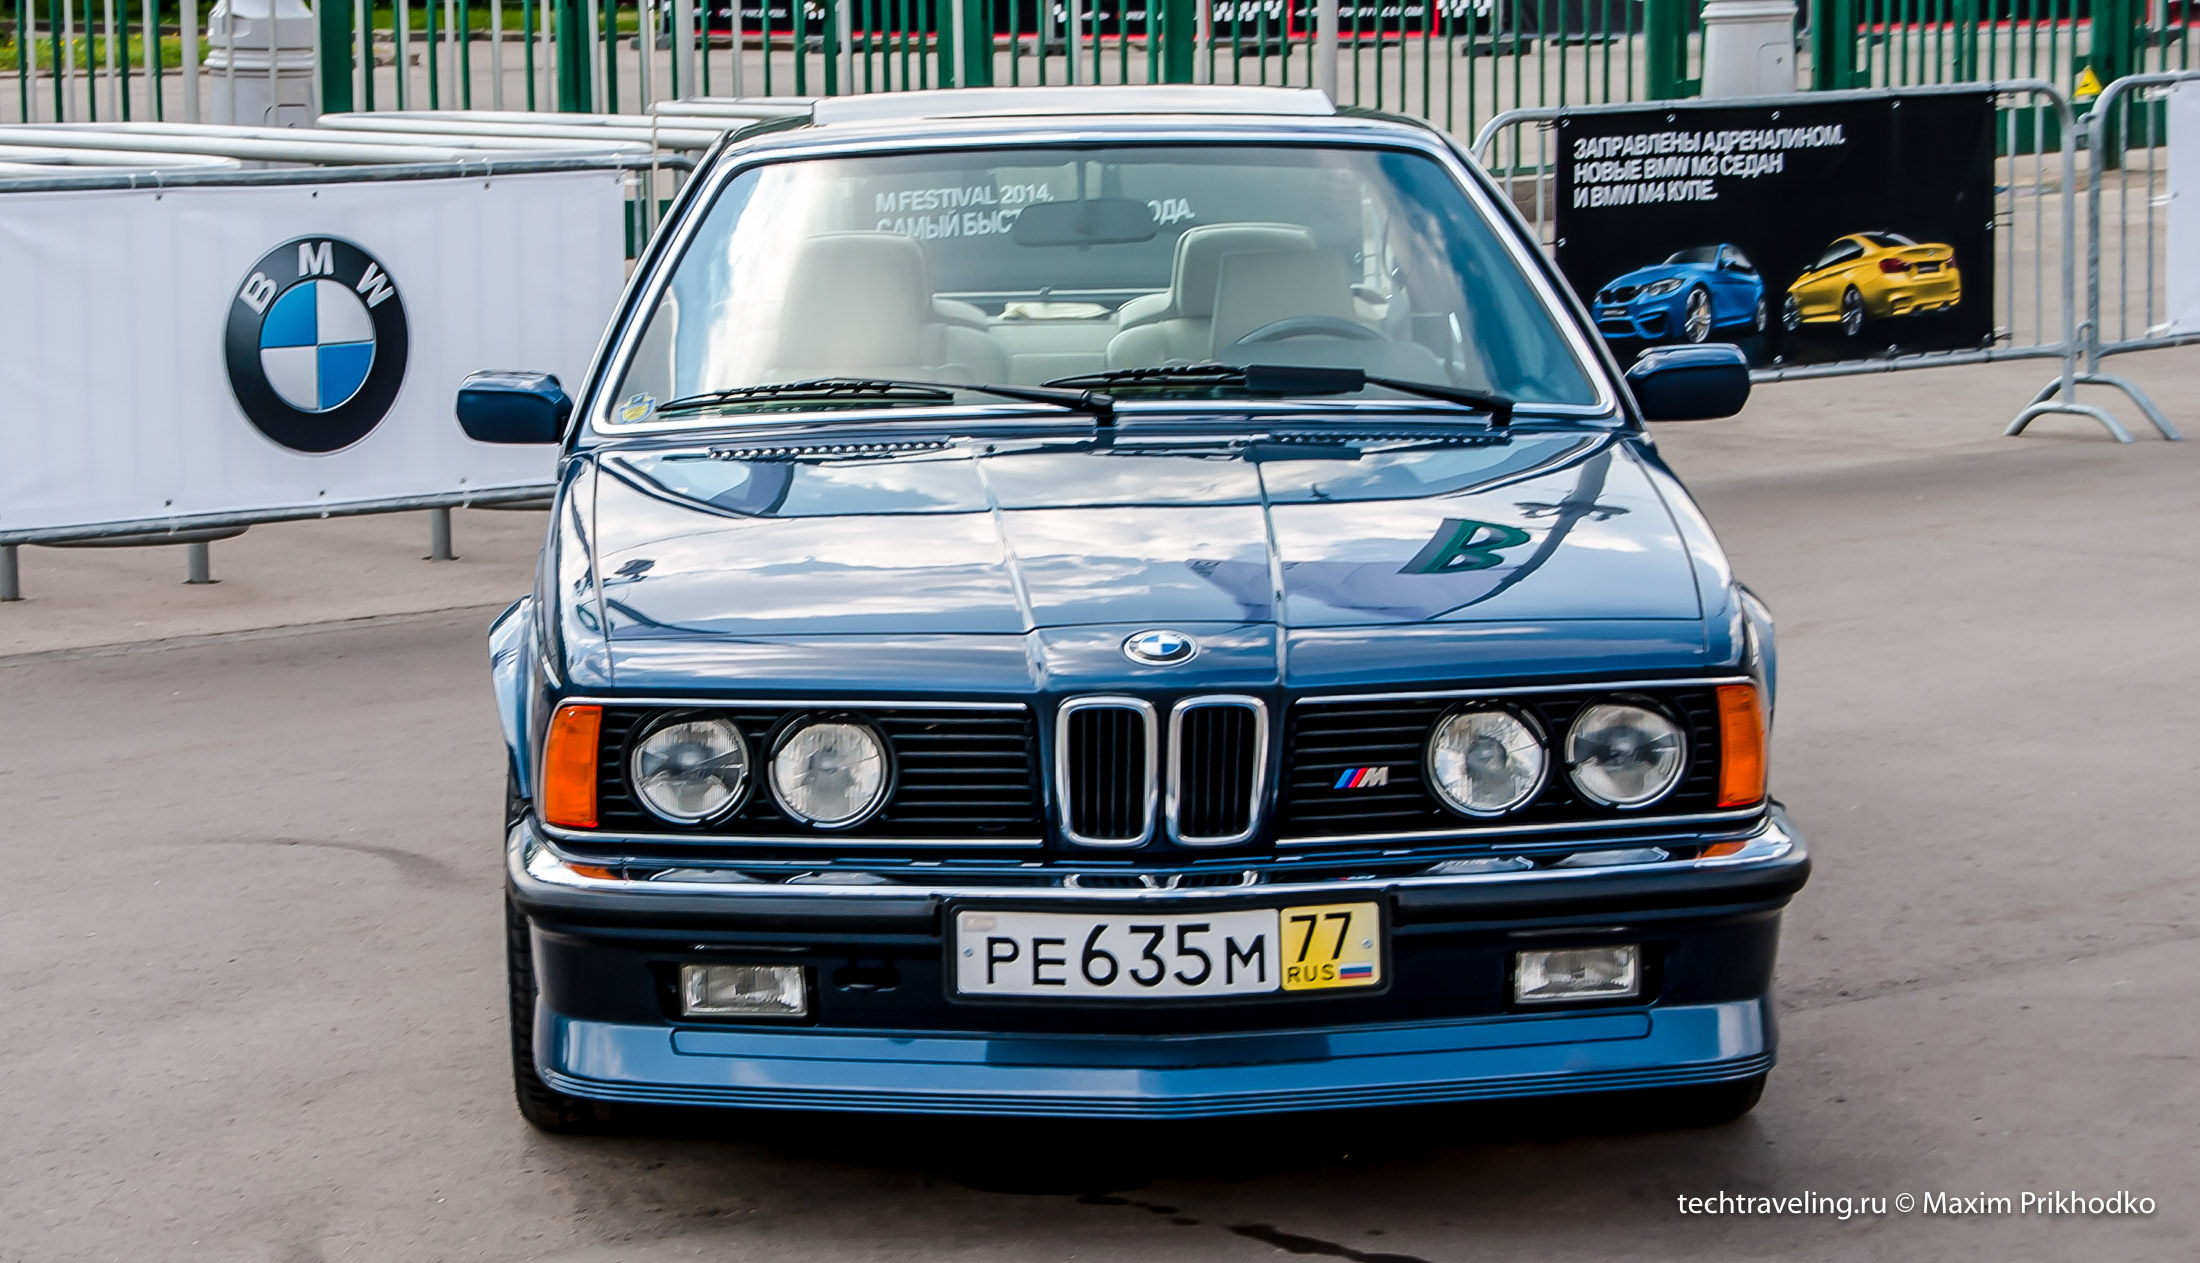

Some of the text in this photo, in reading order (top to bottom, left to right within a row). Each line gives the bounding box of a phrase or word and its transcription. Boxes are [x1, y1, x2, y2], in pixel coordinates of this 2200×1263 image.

[1573, 125, 1846, 159] ЗАПРАВЛЕНЫ АДРЕНАЛИНОМ.
[1573, 152, 1785, 184] НОВЫЕ BMW M3 СЕДАН
[875, 191, 896, 213] M
[898, 184, 999, 212] FESTIVAL
[1573, 179, 1718, 209] И BMW M4 КУПЕ.
[875, 208, 961, 240] САМЫЙ
[961, 208, 1025, 237] БЫСТ
[238, 240, 395, 316] BMW
[1355, 766, 1389, 788] M
[1288, 911, 1354, 963] 77
[1286, 962, 1336, 984] RUS
